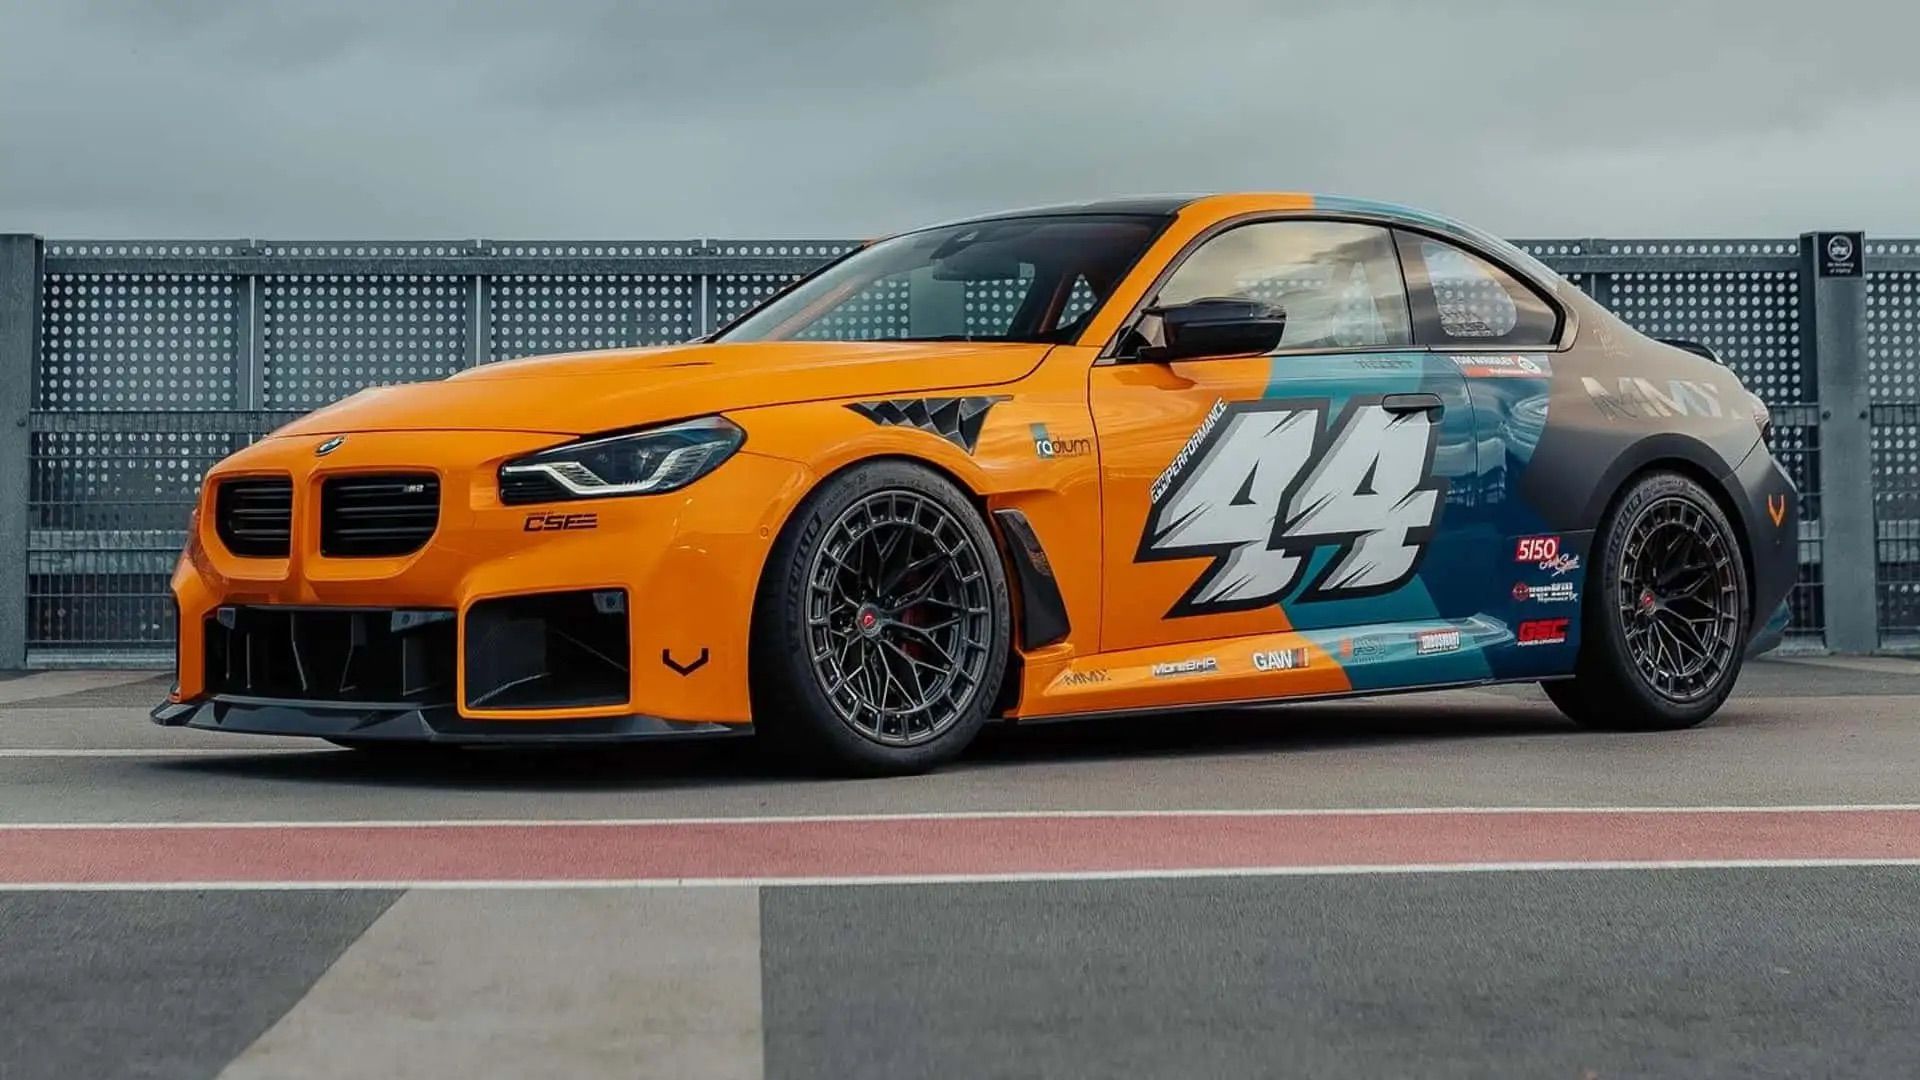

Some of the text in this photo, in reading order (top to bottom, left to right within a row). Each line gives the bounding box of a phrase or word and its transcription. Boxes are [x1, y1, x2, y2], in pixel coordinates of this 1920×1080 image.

[1036, 435, 1091, 456] radium
[1151, 405, 1439, 606] 44
[1519, 540, 1557, 560] 5150
